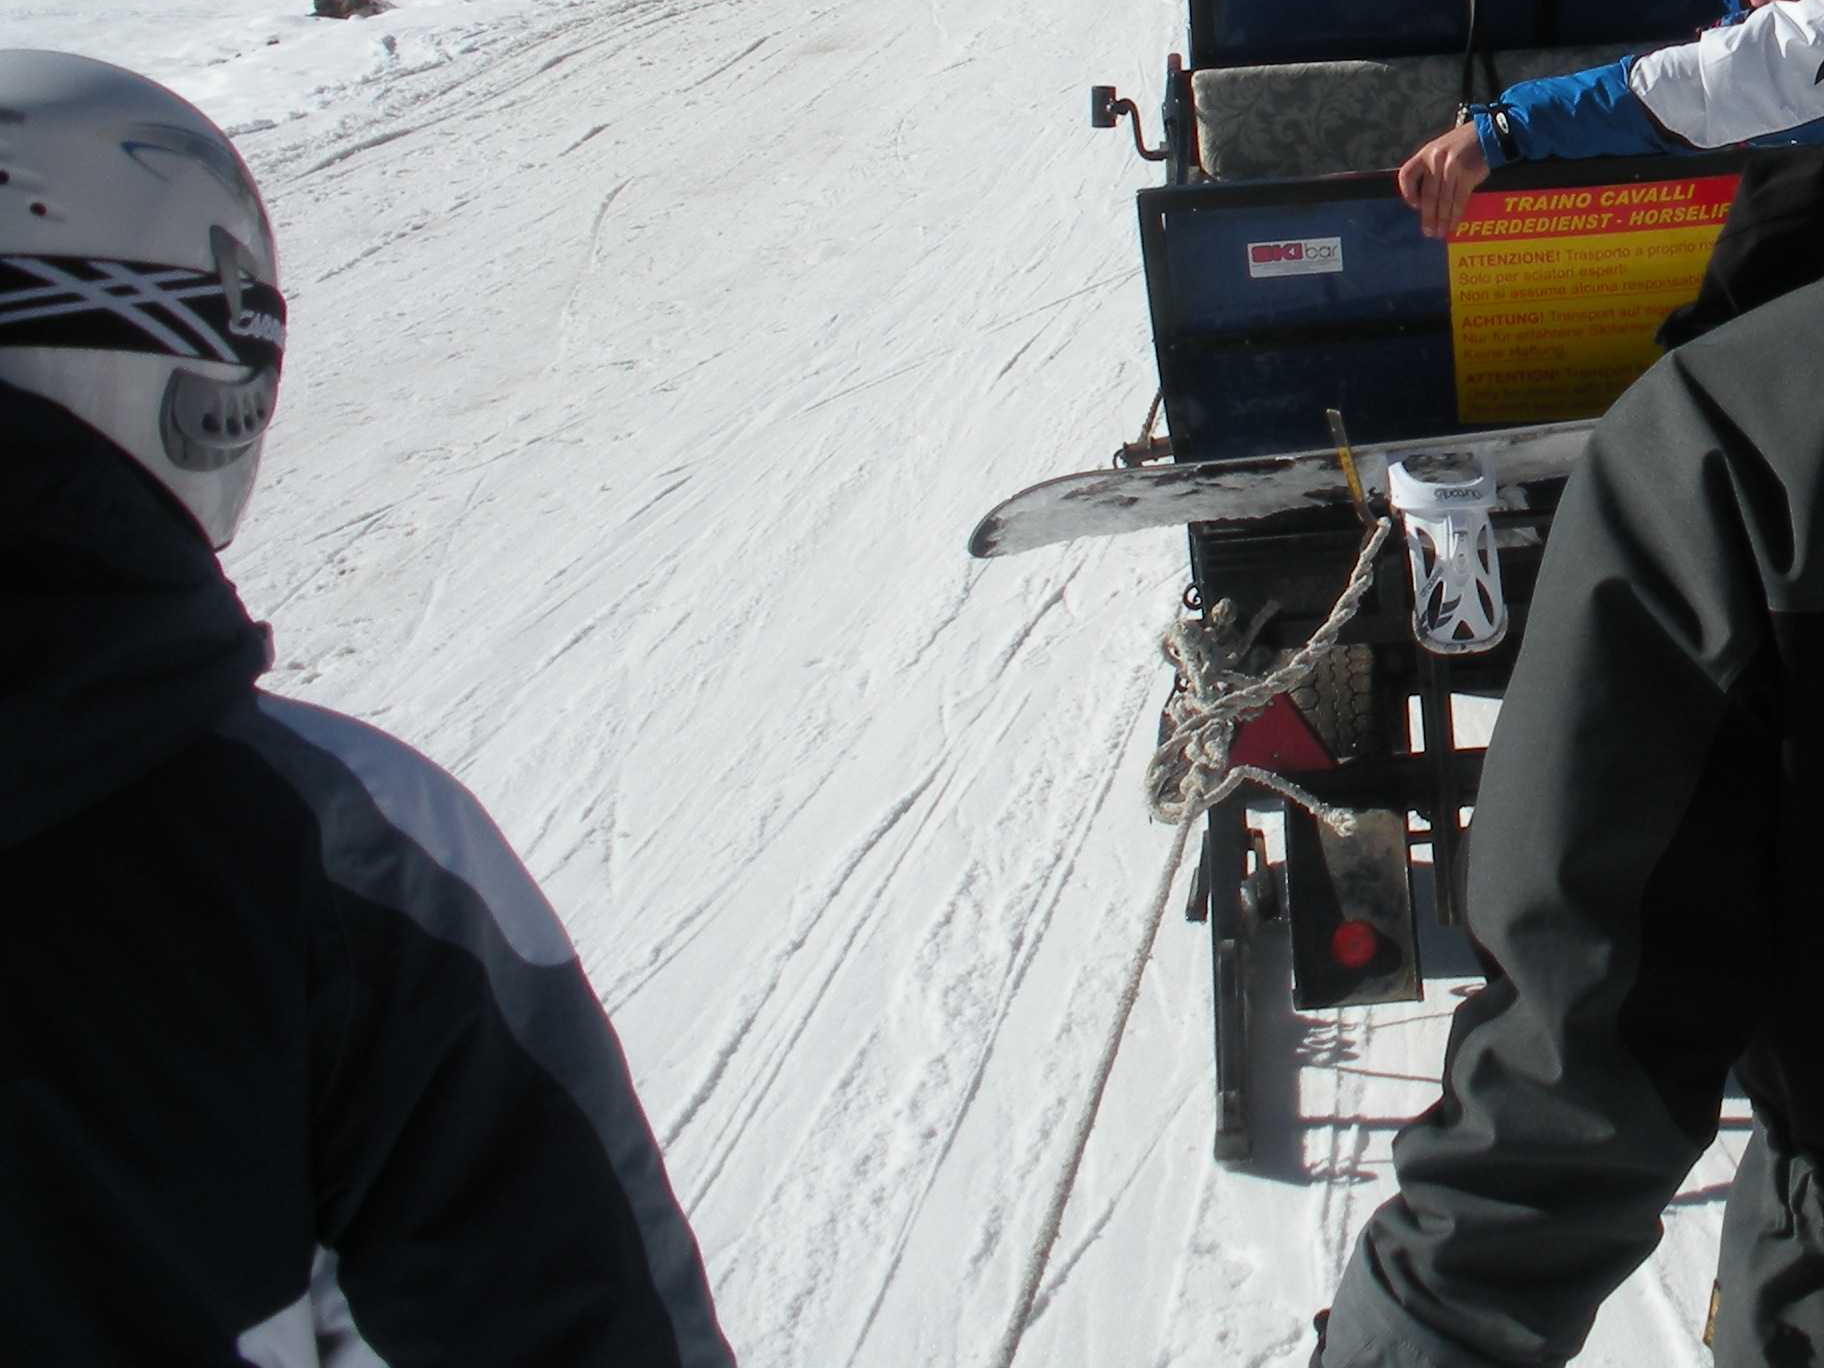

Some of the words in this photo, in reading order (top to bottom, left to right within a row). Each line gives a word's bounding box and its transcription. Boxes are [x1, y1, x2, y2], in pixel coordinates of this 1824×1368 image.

[1504, 192, 1592, 213] TRAINO
[1600, 184, 1695, 207] CAVALLI
[1456, 213, 1613, 237] PFERDEDIENST
[1630, 202, 1732, 225] HORSELIF
[1458, 250, 1561, 269] ATTENZIONE!
[1566, 246, 1631, 262] Trasporto
[1647, 241, 1696, 259] proprio
[1458, 272, 1490, 286] Solo
[1460, 289, 1489, 302] Non
[1462, 311, 1544, 328] ACHTUNG!
